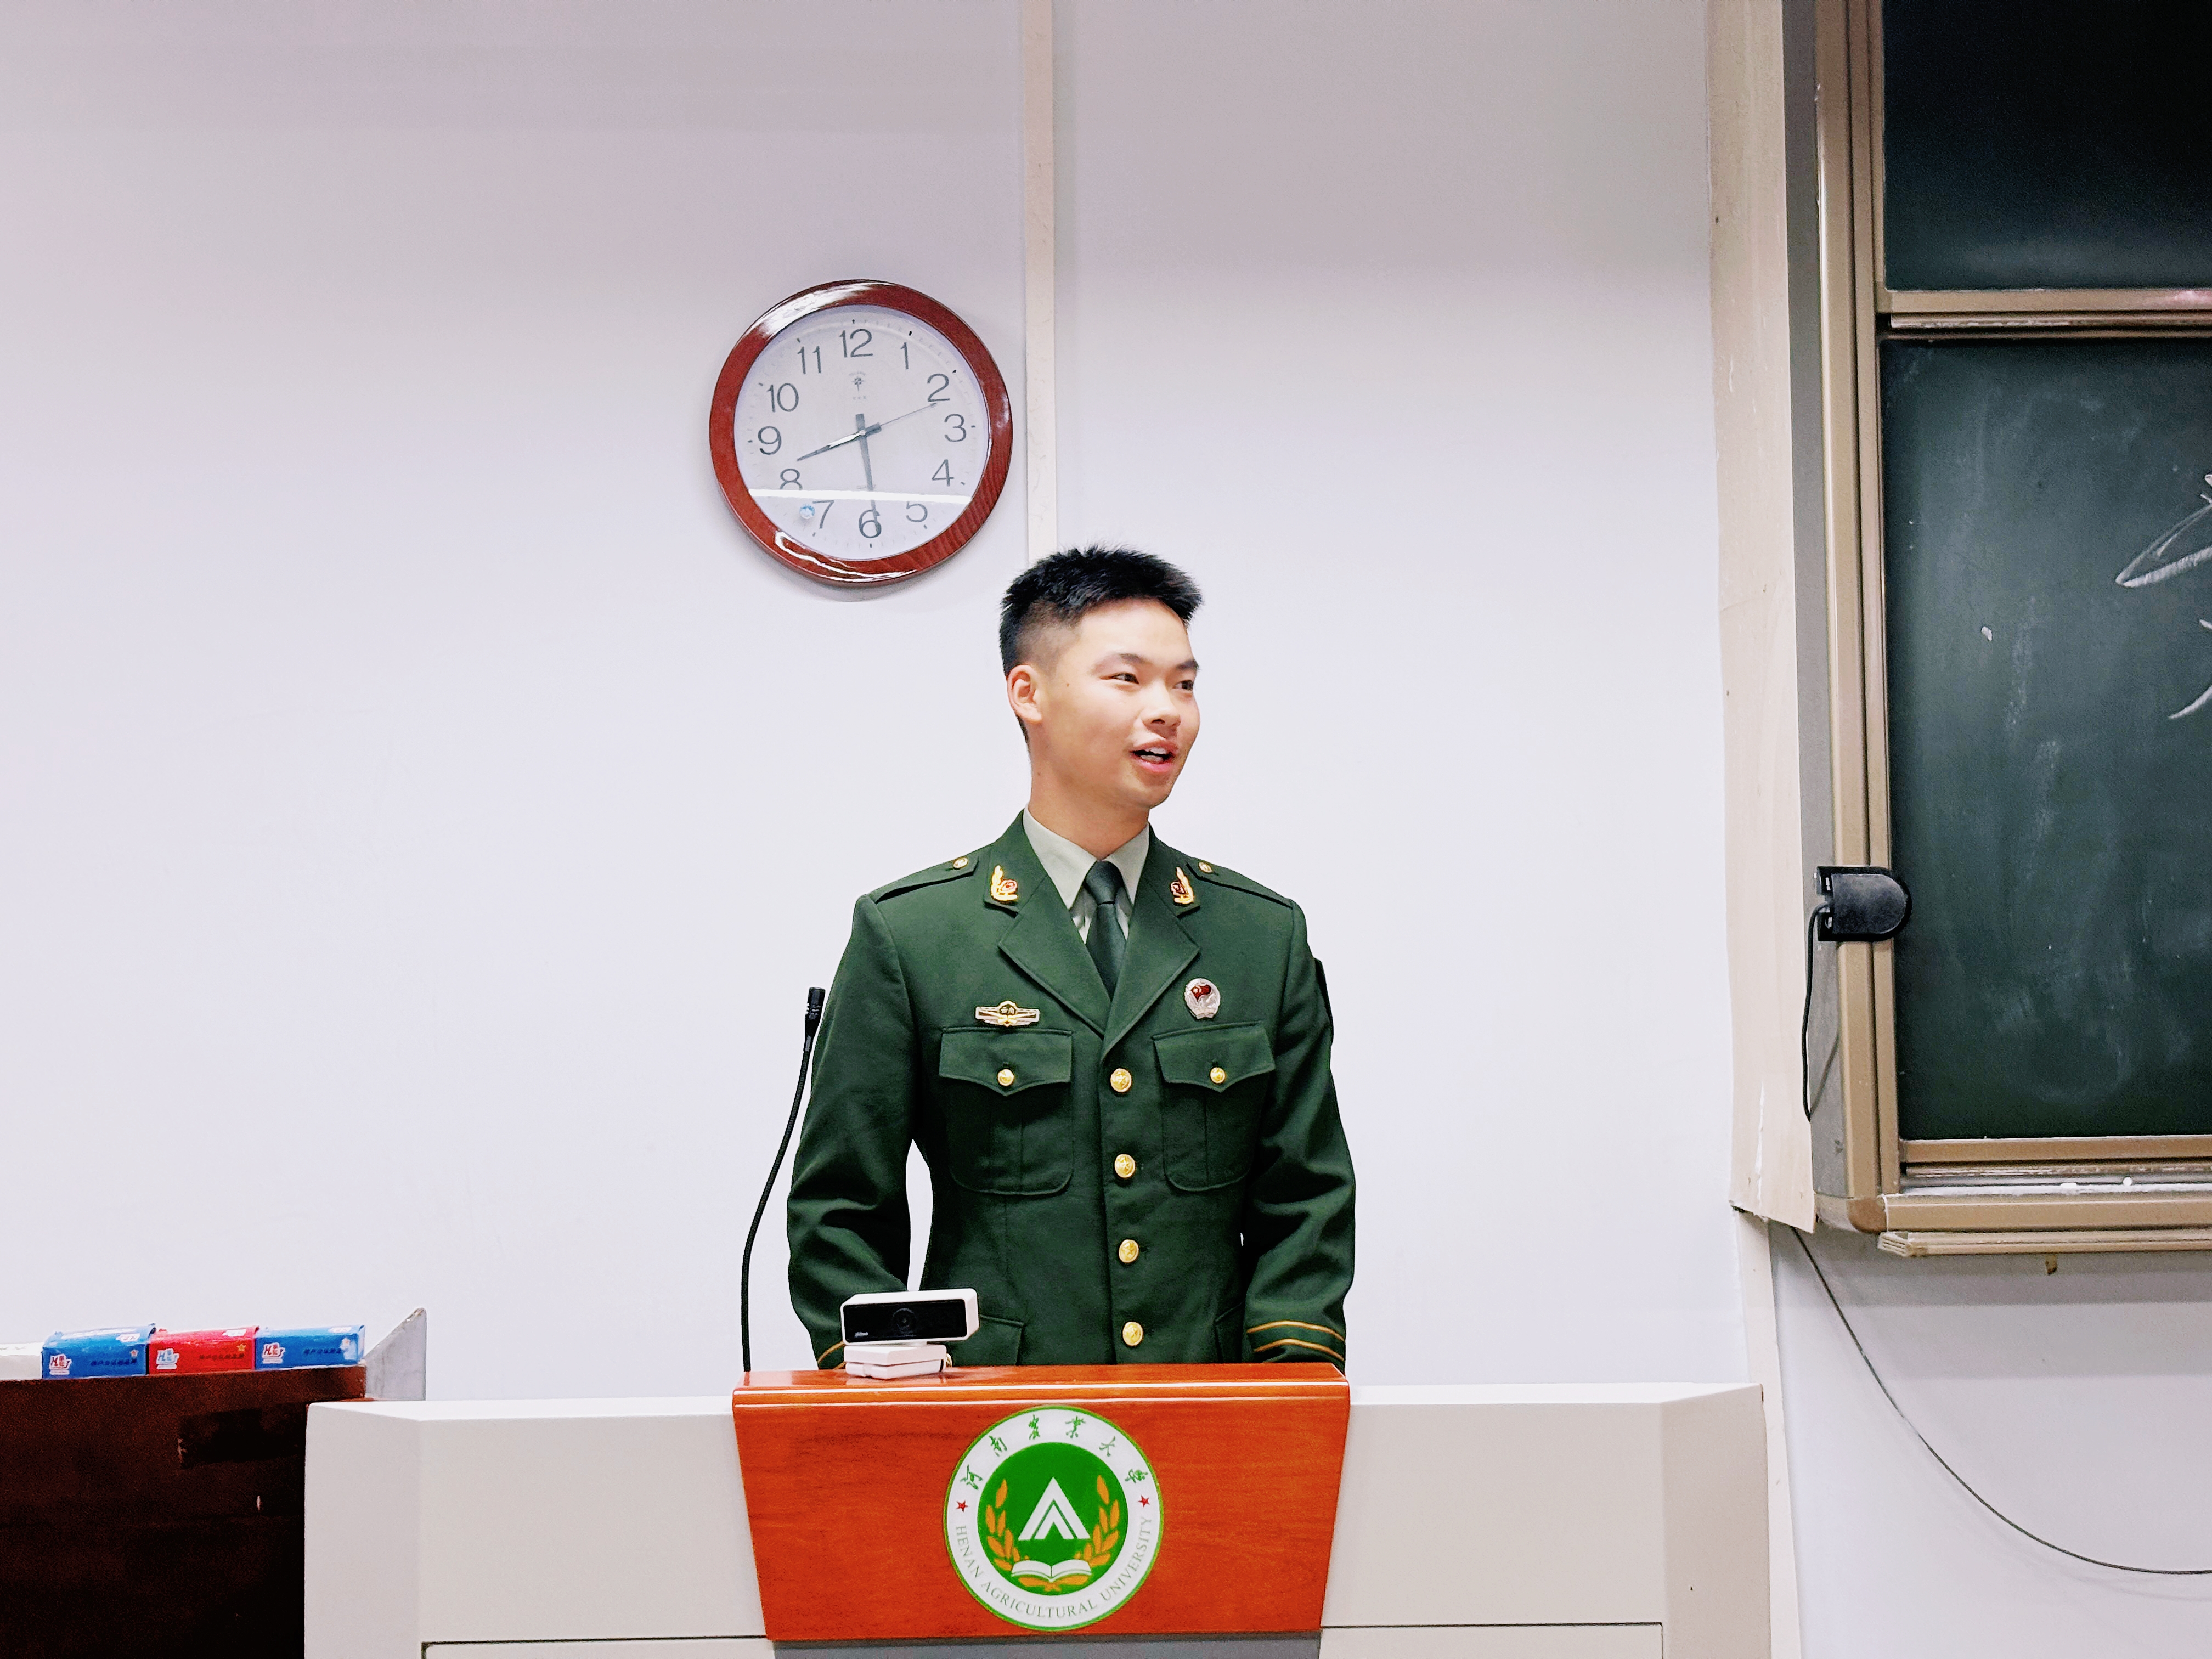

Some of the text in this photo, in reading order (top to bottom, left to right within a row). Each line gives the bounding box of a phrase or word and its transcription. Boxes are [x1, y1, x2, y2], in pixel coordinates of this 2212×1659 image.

[839, 328, 873, 358] 12
[900, 342, 909, 370] 1
[797, 346, 822, 374] 11
[767, 383, 799, 413] 10
[927, 374, 950, 402] 2
[758, 426, 781, 455] 9
[944, 414, 967, 442] 3
[780, 469, 803, 490] 8
[932, 459, 954, 487] 4
[813, 500, 834, 529] 7
[858, 509, 882, 539] 6
[905, 501, 928, 523] 5
[956, 1517, 1152, 1618] HENAN AGRICULTURAL UNIVERSITY
